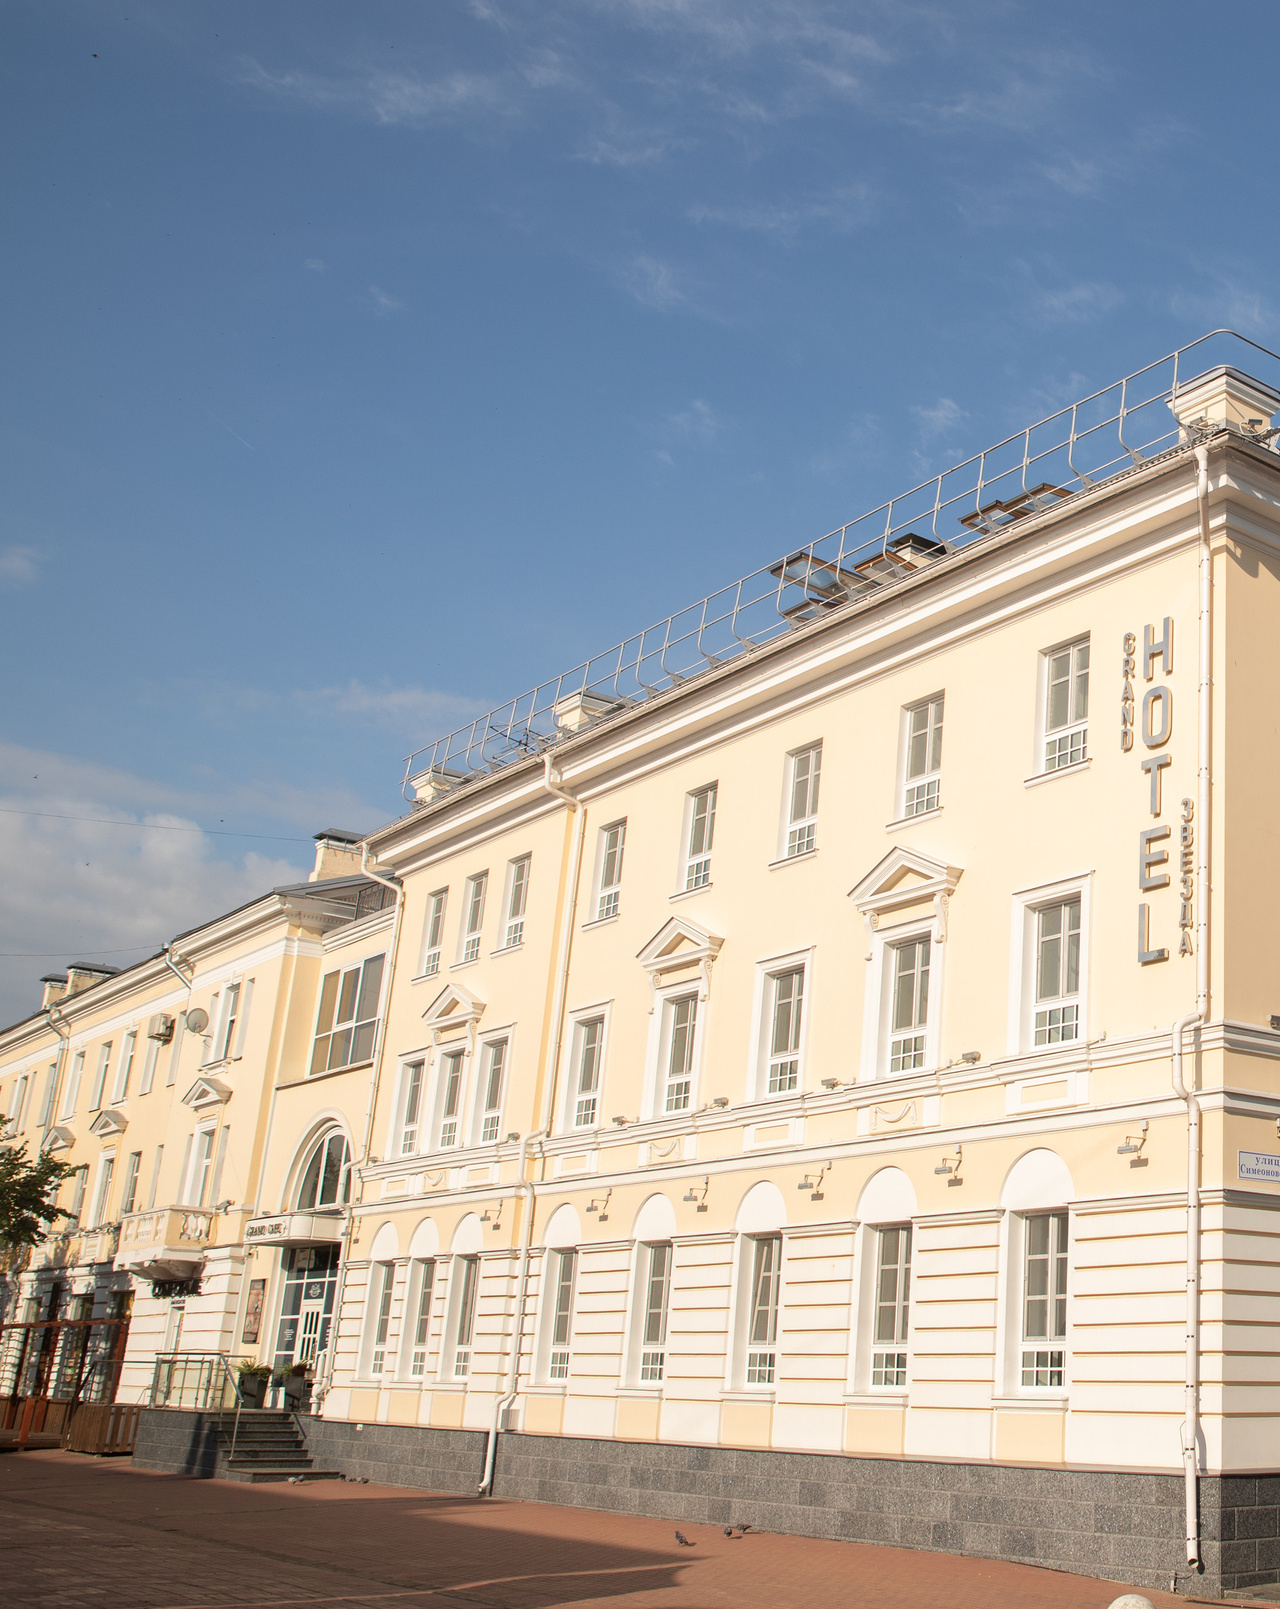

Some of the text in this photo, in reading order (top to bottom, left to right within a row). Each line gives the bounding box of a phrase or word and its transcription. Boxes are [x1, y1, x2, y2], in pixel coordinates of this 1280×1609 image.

[1121, 632, 1136, 752] GRAND
[1138, 616, 1174, 967] HOTEL
[1179, 798, 1194, 957] ЗВЕЗДА
